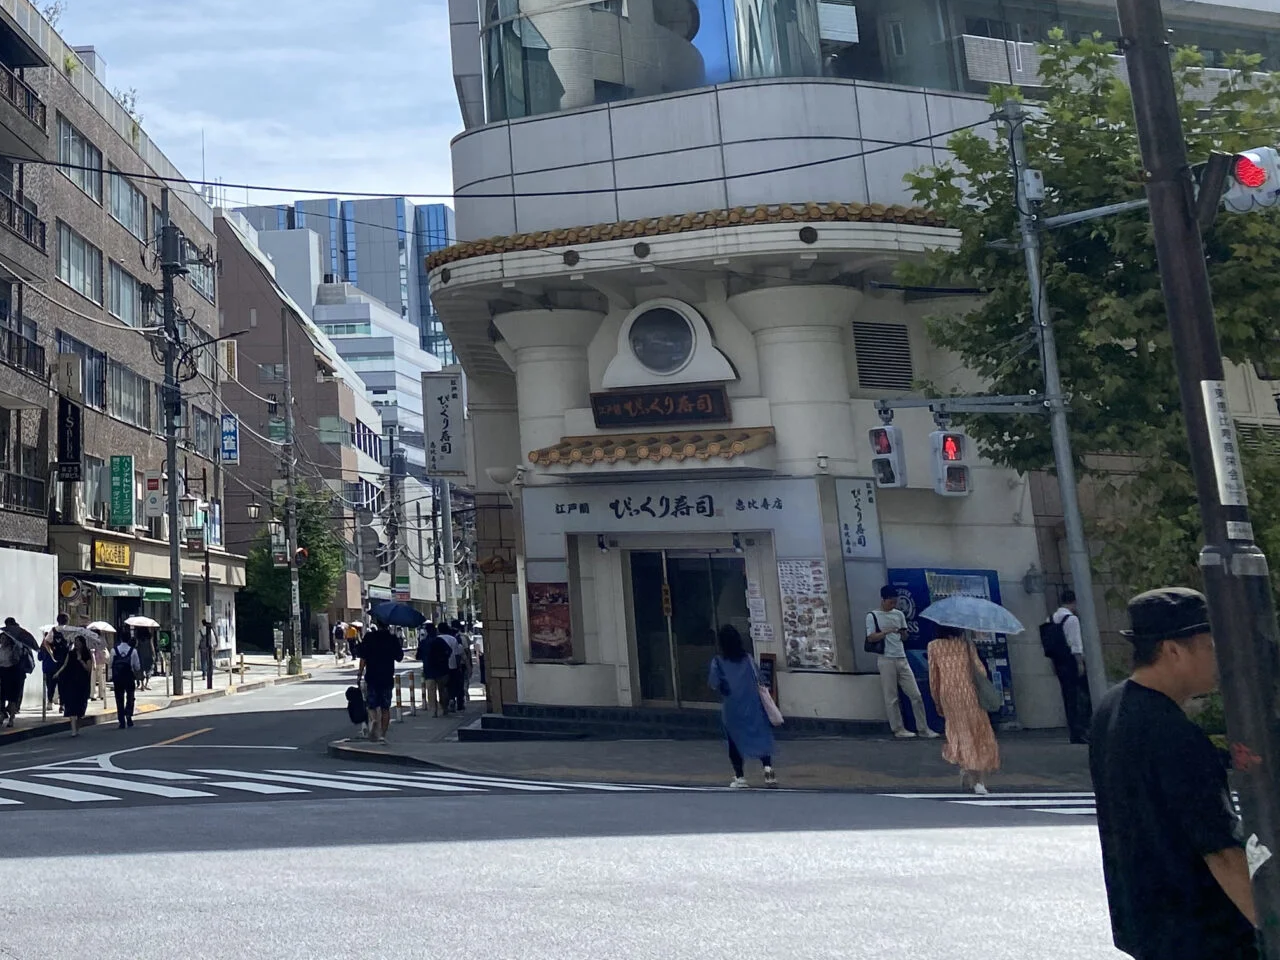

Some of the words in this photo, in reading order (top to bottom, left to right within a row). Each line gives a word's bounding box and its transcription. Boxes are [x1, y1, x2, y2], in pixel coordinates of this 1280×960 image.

[623, 394, 714, 417] びっくり寿司
[436, 394, 453, 455] びっくり寿司
[608, 494, 715, 519] びっくり寿司
[735, 497, 783, 512] 恵比寿店
[850, 488, 867, 548] びっくり寿司
